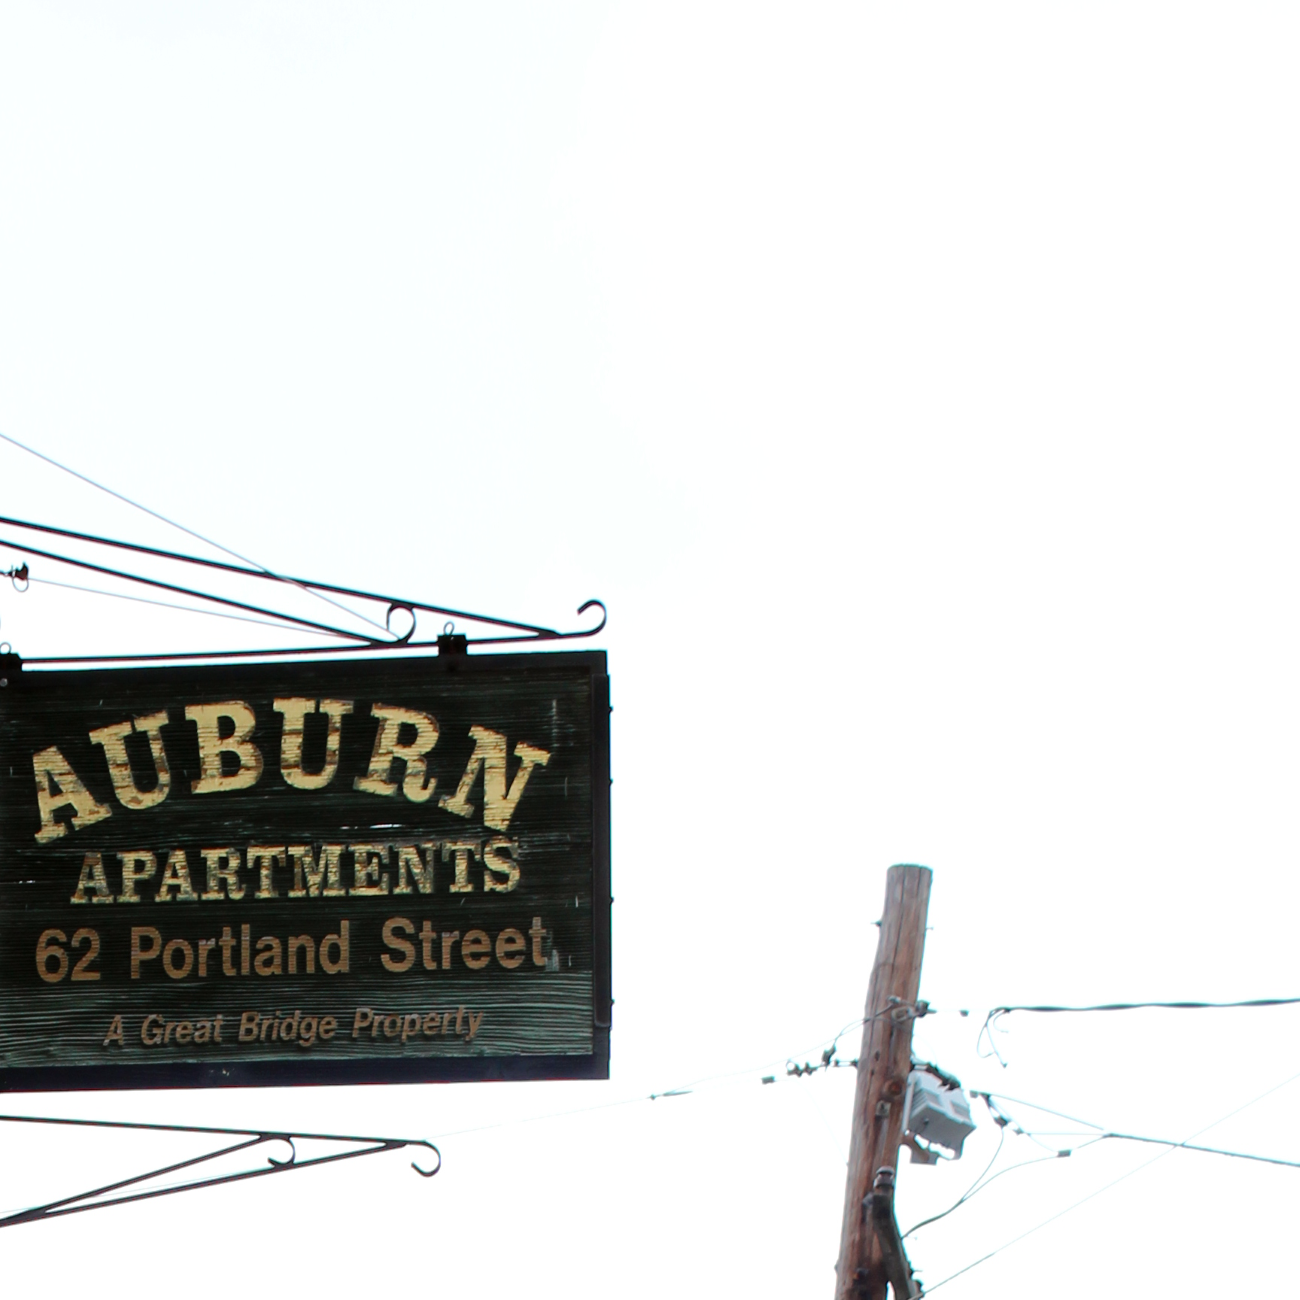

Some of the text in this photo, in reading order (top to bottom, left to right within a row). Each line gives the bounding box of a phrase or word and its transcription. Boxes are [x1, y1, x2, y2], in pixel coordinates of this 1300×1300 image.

[32, 697, 551, 844] AUBURN
[70, 836, 521, 904] APARTMENTS
[35, 916, 547, 983] 62 Portland Street
[103, 1004, 484, 1047] A Great Bridge Property
